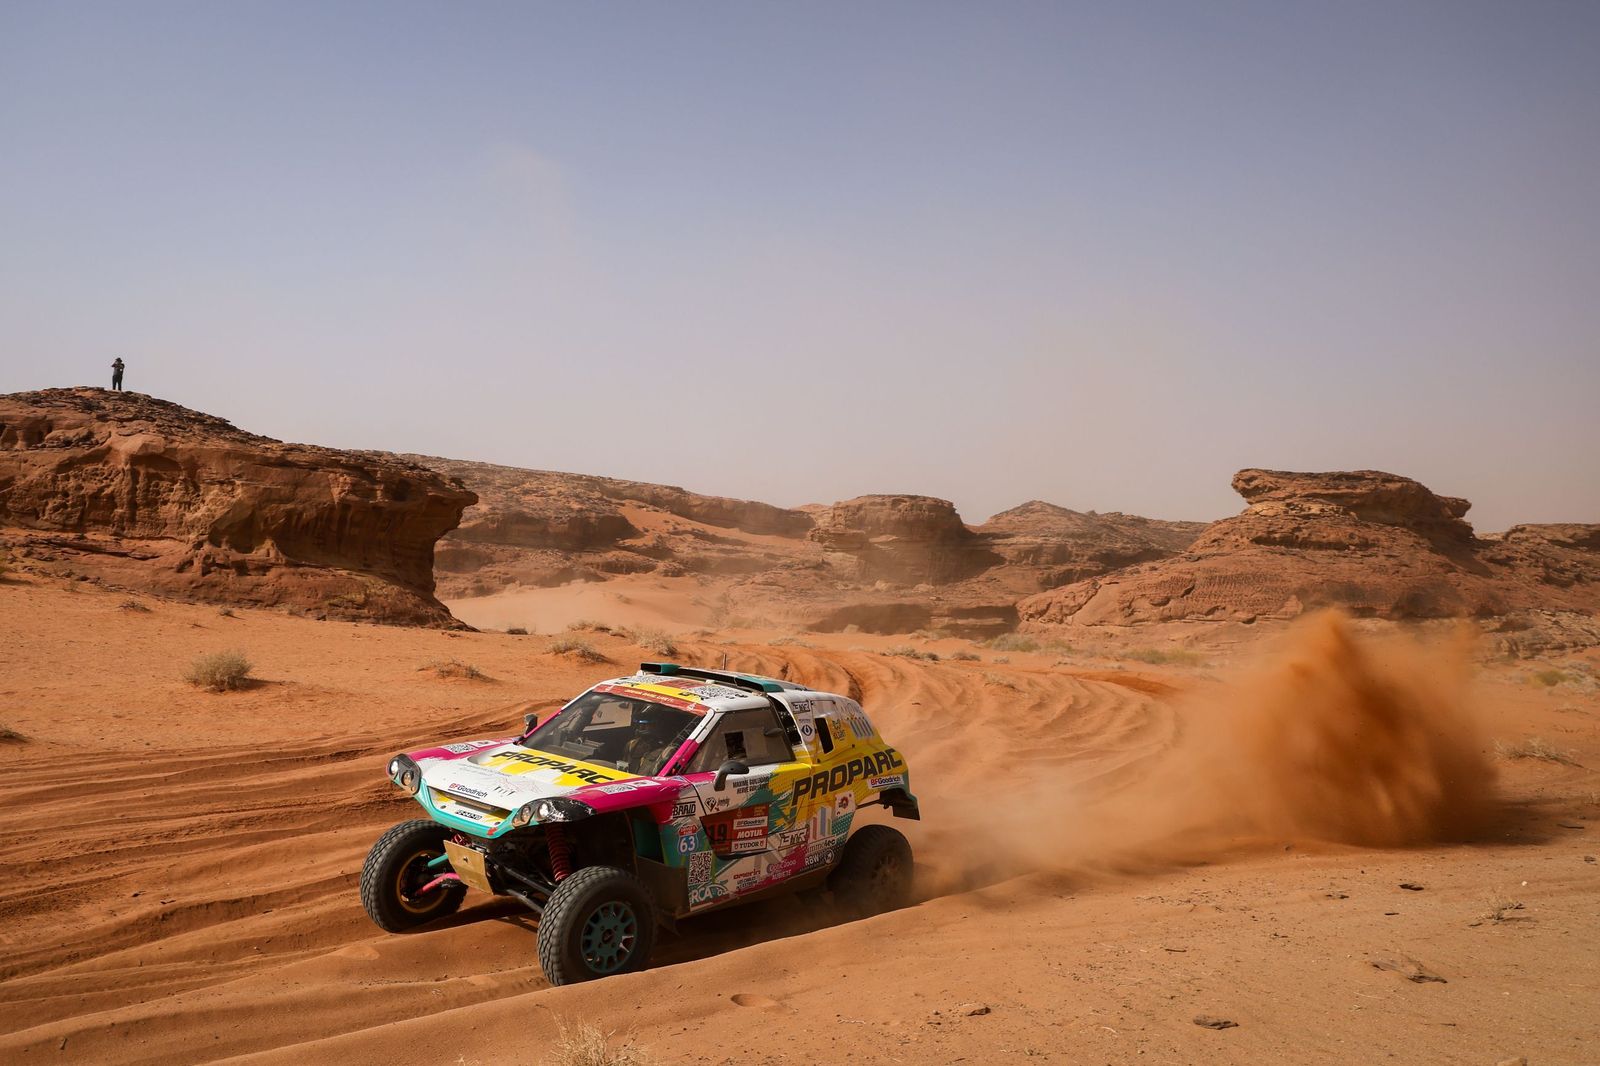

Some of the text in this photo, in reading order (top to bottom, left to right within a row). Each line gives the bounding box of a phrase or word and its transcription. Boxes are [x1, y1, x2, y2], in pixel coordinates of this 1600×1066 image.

[491, 751, 615, 784] PROPARC
[792, 748, 903, 806] PROPARC
[870, 777, 901, 785] BFGoodrich
[449, 783, 488, 798] BFGoodrich
[673, 803, 696, 816] BRAID
[737, 829, 763, 839] MOTUL
[680, 836, 695, 852] 63
[691, 886, 713, 903] RCA
